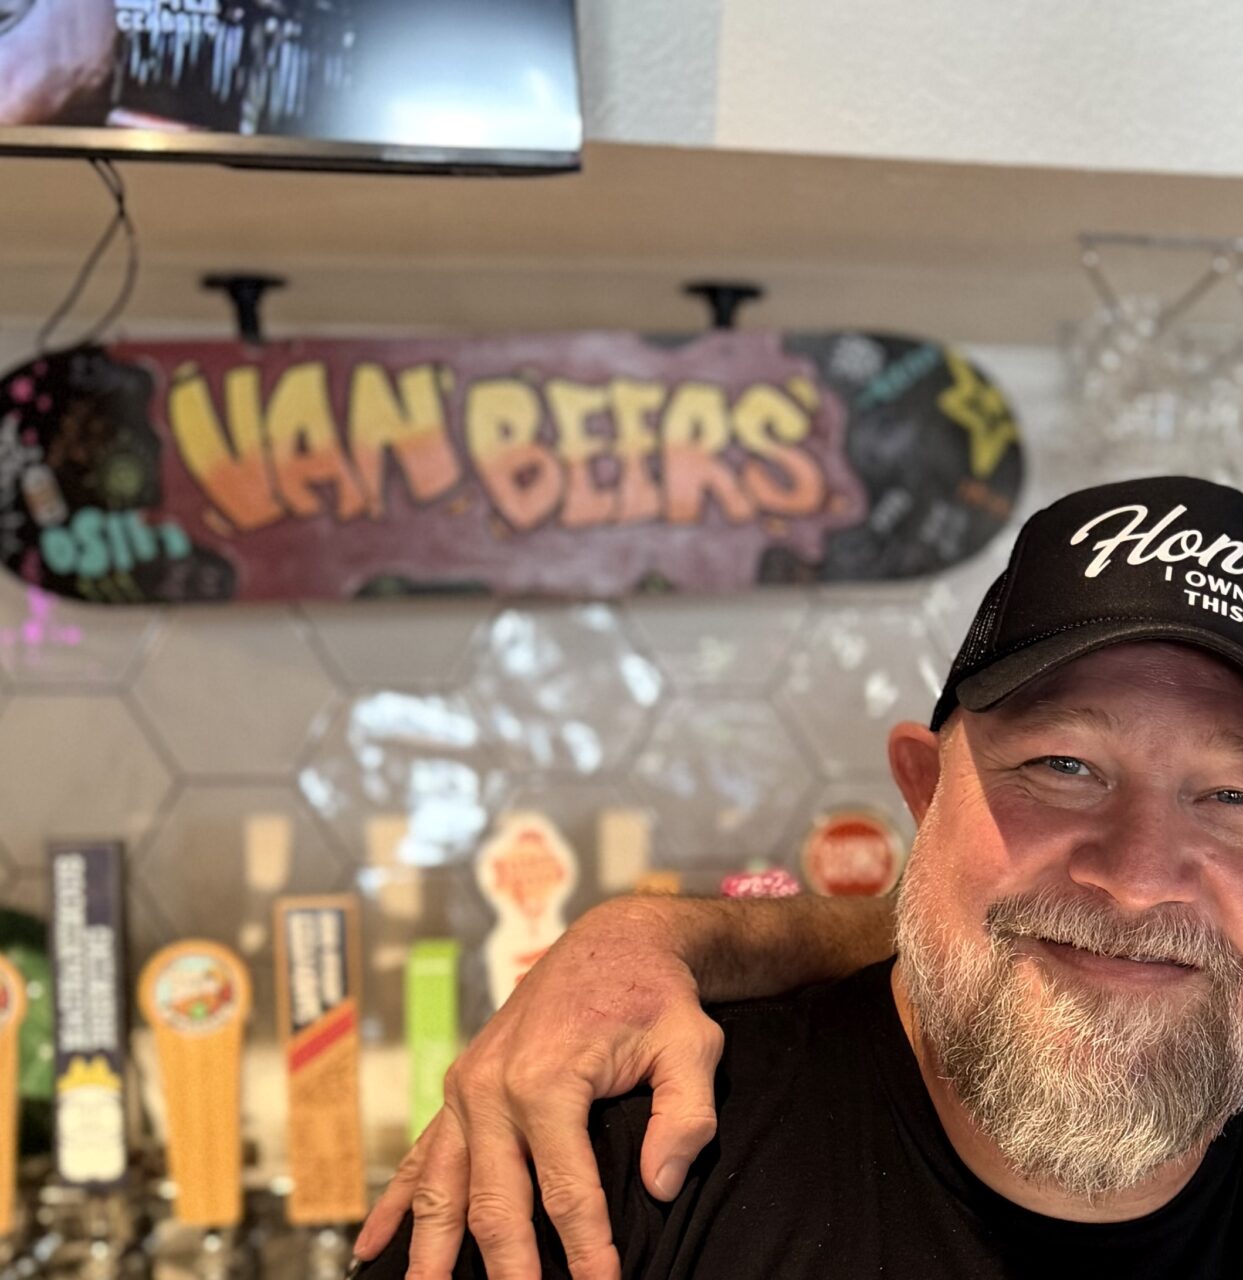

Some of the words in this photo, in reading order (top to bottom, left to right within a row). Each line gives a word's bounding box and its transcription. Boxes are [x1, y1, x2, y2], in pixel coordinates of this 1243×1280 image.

[169, 362, 463, 532] VAN
[466, 378, 828, 532] BEERS
[1164, 566, 1173, 581] I
[1183, 589, 1243, 623] THIS
